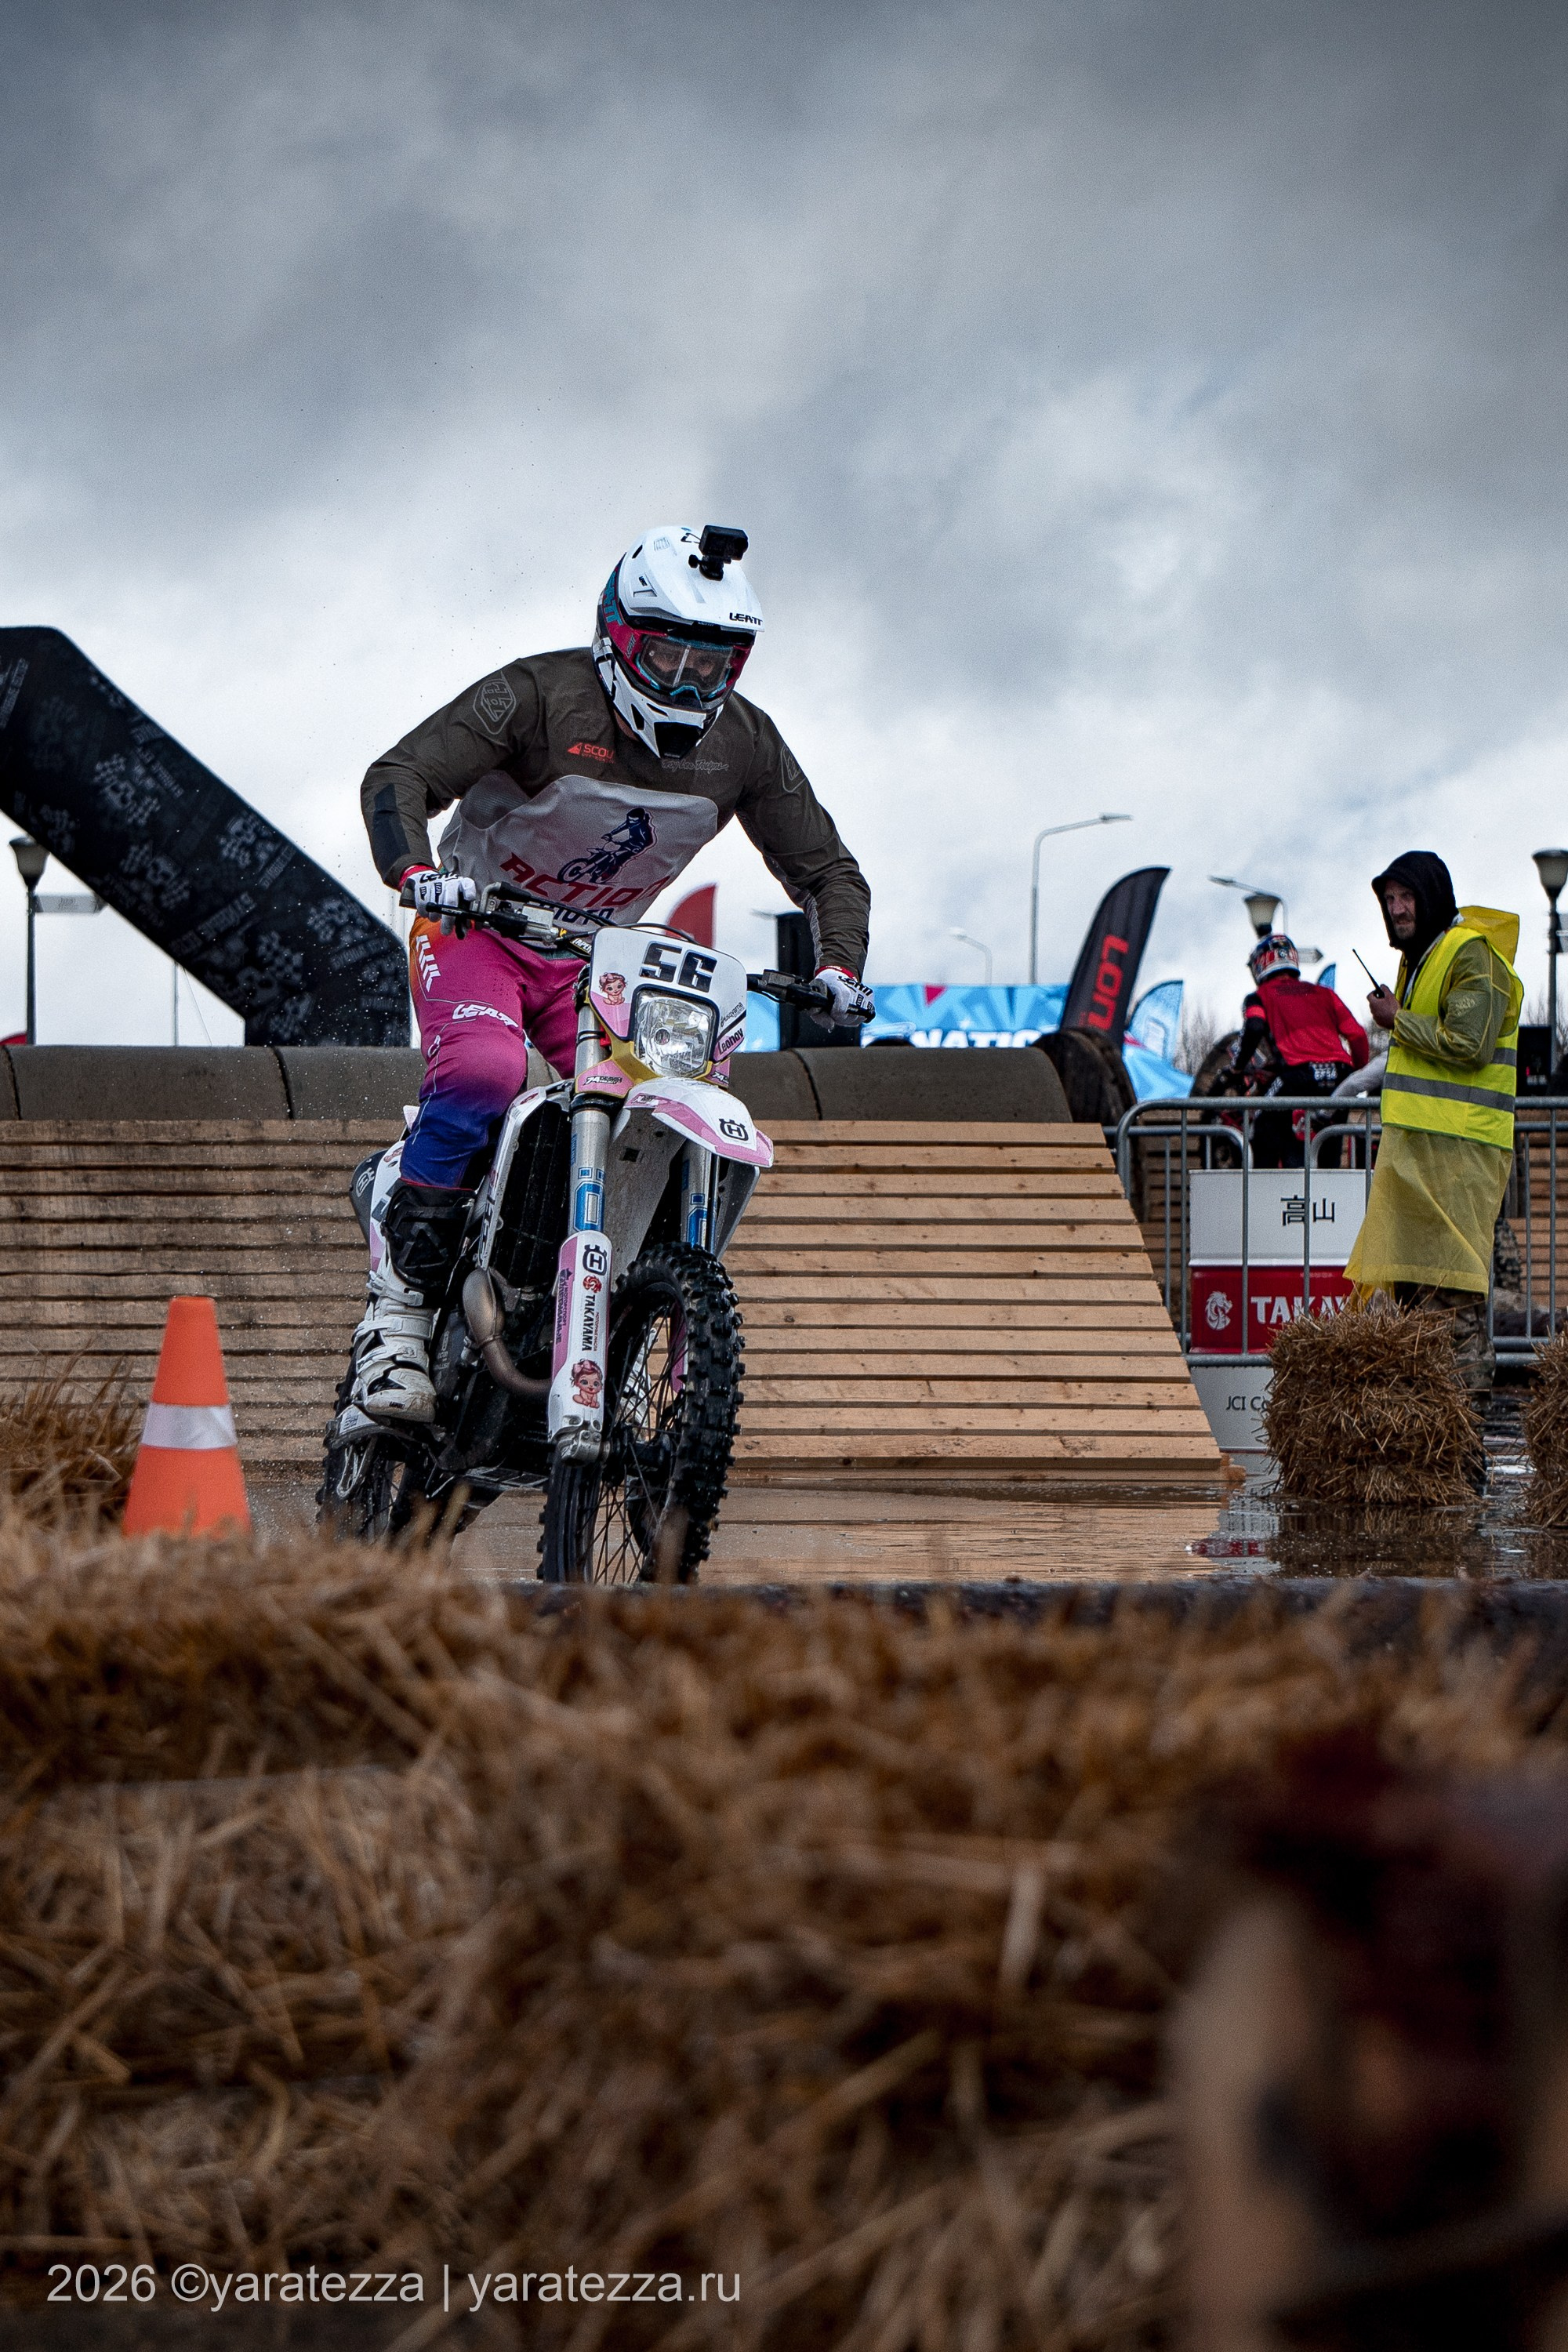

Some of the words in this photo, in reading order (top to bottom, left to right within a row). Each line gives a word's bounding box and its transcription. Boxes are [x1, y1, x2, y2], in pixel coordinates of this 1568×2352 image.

[729, 612, 763, 626] LEATT
[539, 903, 615, 925] OTO
[639, 941, 717, 993] 56
[452, 1004, 519, 1028] LEATT
[717, 1028, 744, 1055] Leonov
[1280, 1194, 1335, 1226] 高山
[582, 1294, 596, 1352] TAKAYAMA
[1225, 1395, 1247, 1410] JCI
